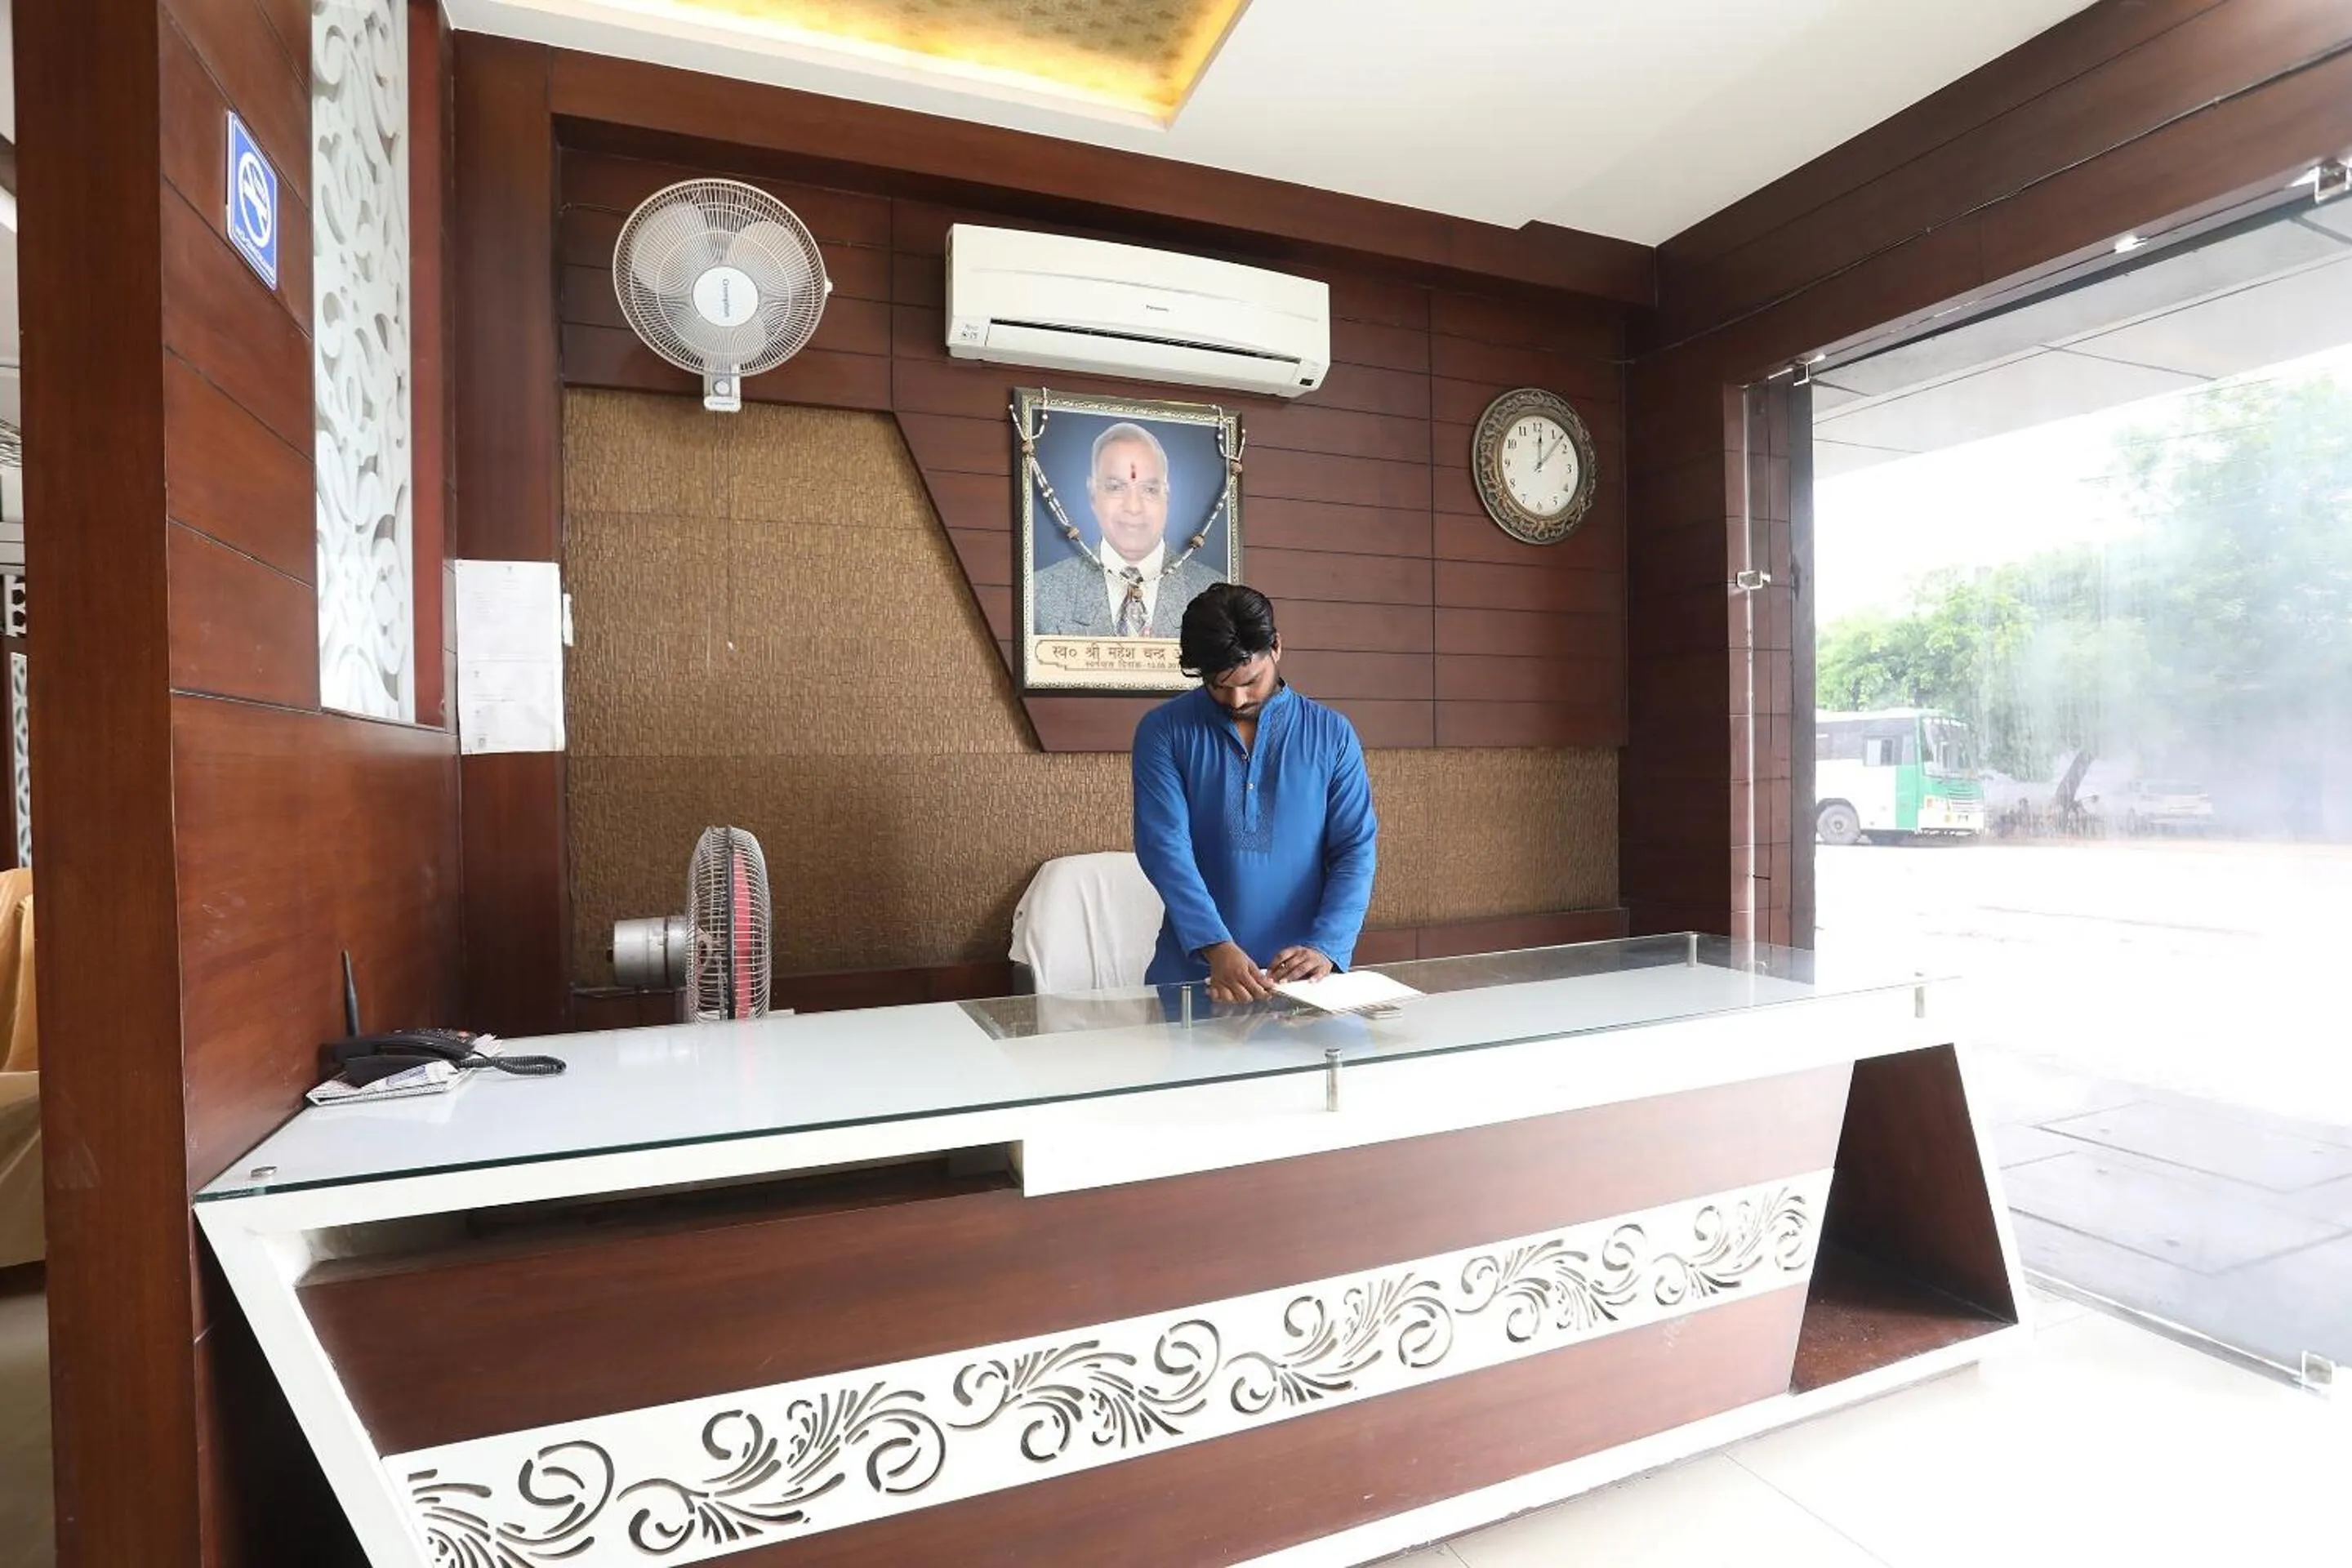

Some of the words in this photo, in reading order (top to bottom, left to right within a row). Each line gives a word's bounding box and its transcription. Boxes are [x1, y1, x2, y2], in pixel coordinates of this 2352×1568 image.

[1518, 425, 1527, 436] 11
[1532, 422, 1543, 433] 12
[1552, 429, 1557, 439] 1
[1508, 439, 1517, 449] 10
[1561, 443, 1567, 454] 2
[1504, 458, 1511, 468] 9
[1566, 463, 1572, 474] 3
[1509, 478, 1516, 489] 8
[1552, 496, 1558, 506] 5
[1085, 641, 1101, 663] श्री
[1107, 643, 1135, 662] महेश
